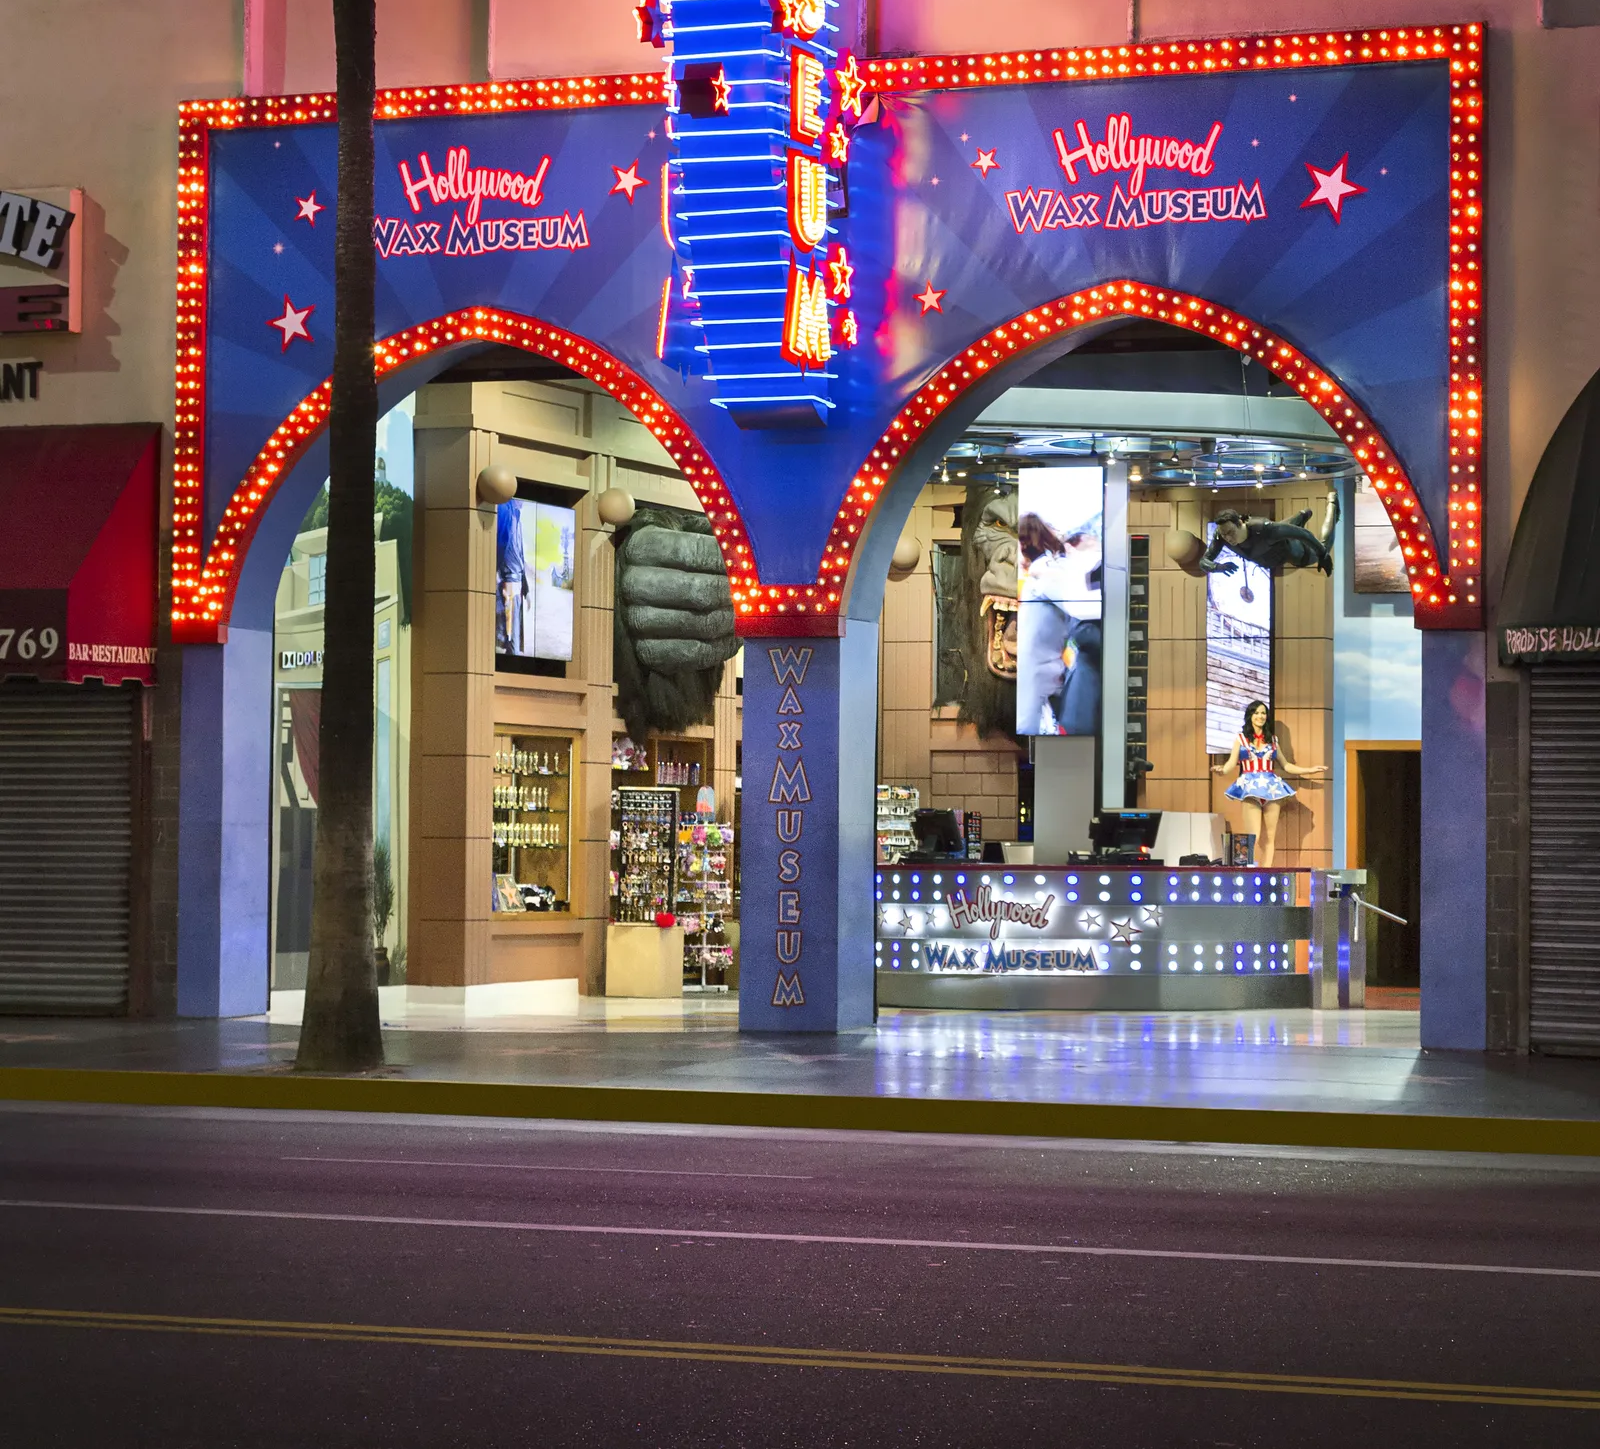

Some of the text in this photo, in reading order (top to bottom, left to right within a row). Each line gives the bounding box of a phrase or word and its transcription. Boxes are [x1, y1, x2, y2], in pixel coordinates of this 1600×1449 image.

[1052, 112, 1223, 198] Hollywood
[399, 145, 551, 225] Hollywood
[1004, 179, 1267, 234] WAX MUSEUM
[374, 210, 590, 258] WAX MUSEUM
[296, 650, 325, 667] DOLB
[767, 647, 813, 1006] WAX MUSEUM
[946, 885, 1055, 939] Hollywood
[923, 941, 1099, 974] WAX MUSEUM
